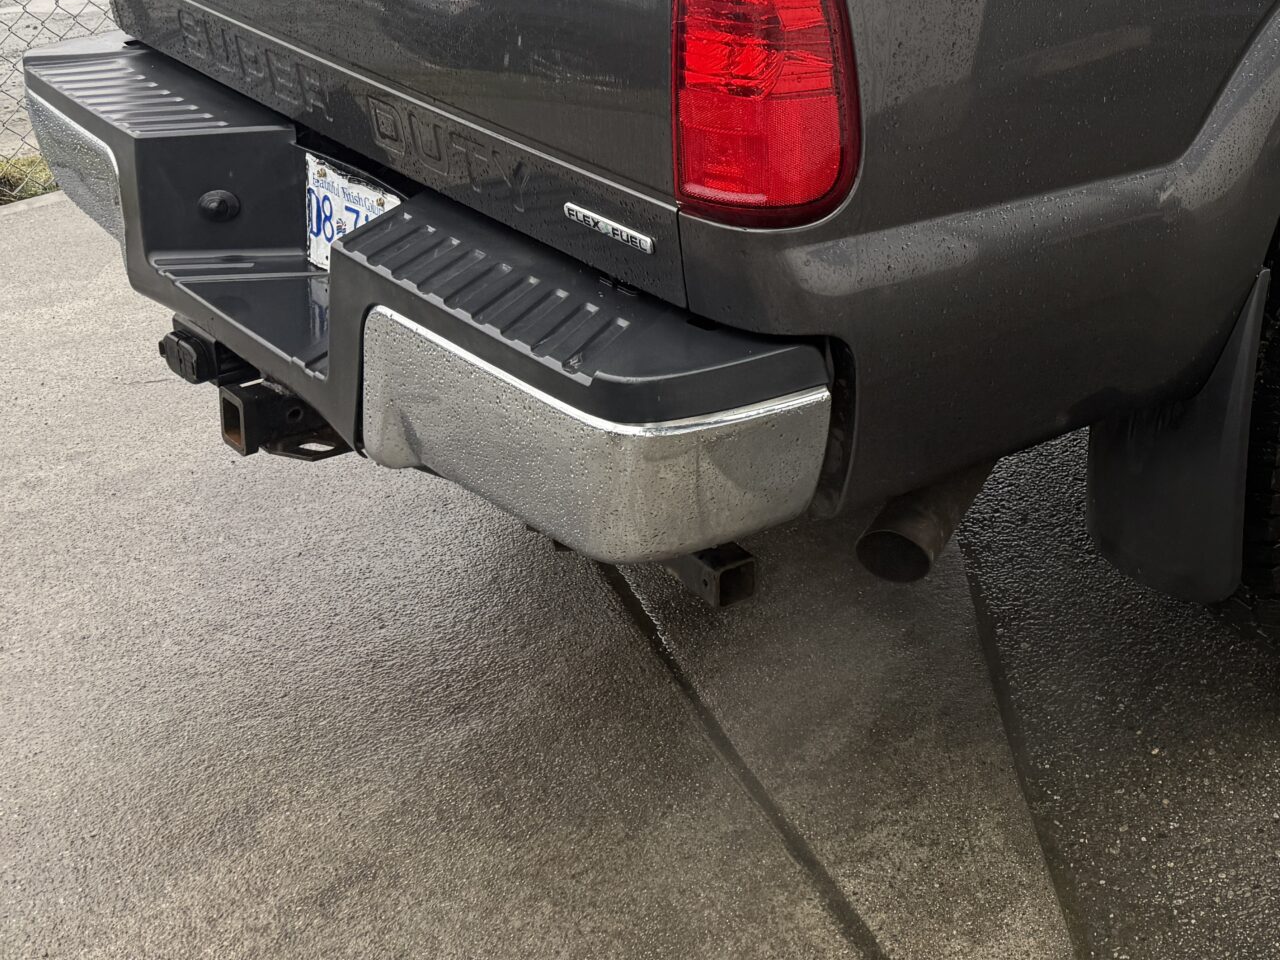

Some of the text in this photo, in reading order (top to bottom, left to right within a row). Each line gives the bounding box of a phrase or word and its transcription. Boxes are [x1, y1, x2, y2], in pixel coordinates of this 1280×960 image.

[178, 8, 529, 212] SUPER DUTY
[567, 207, 648, 252] FLEX FUEL
